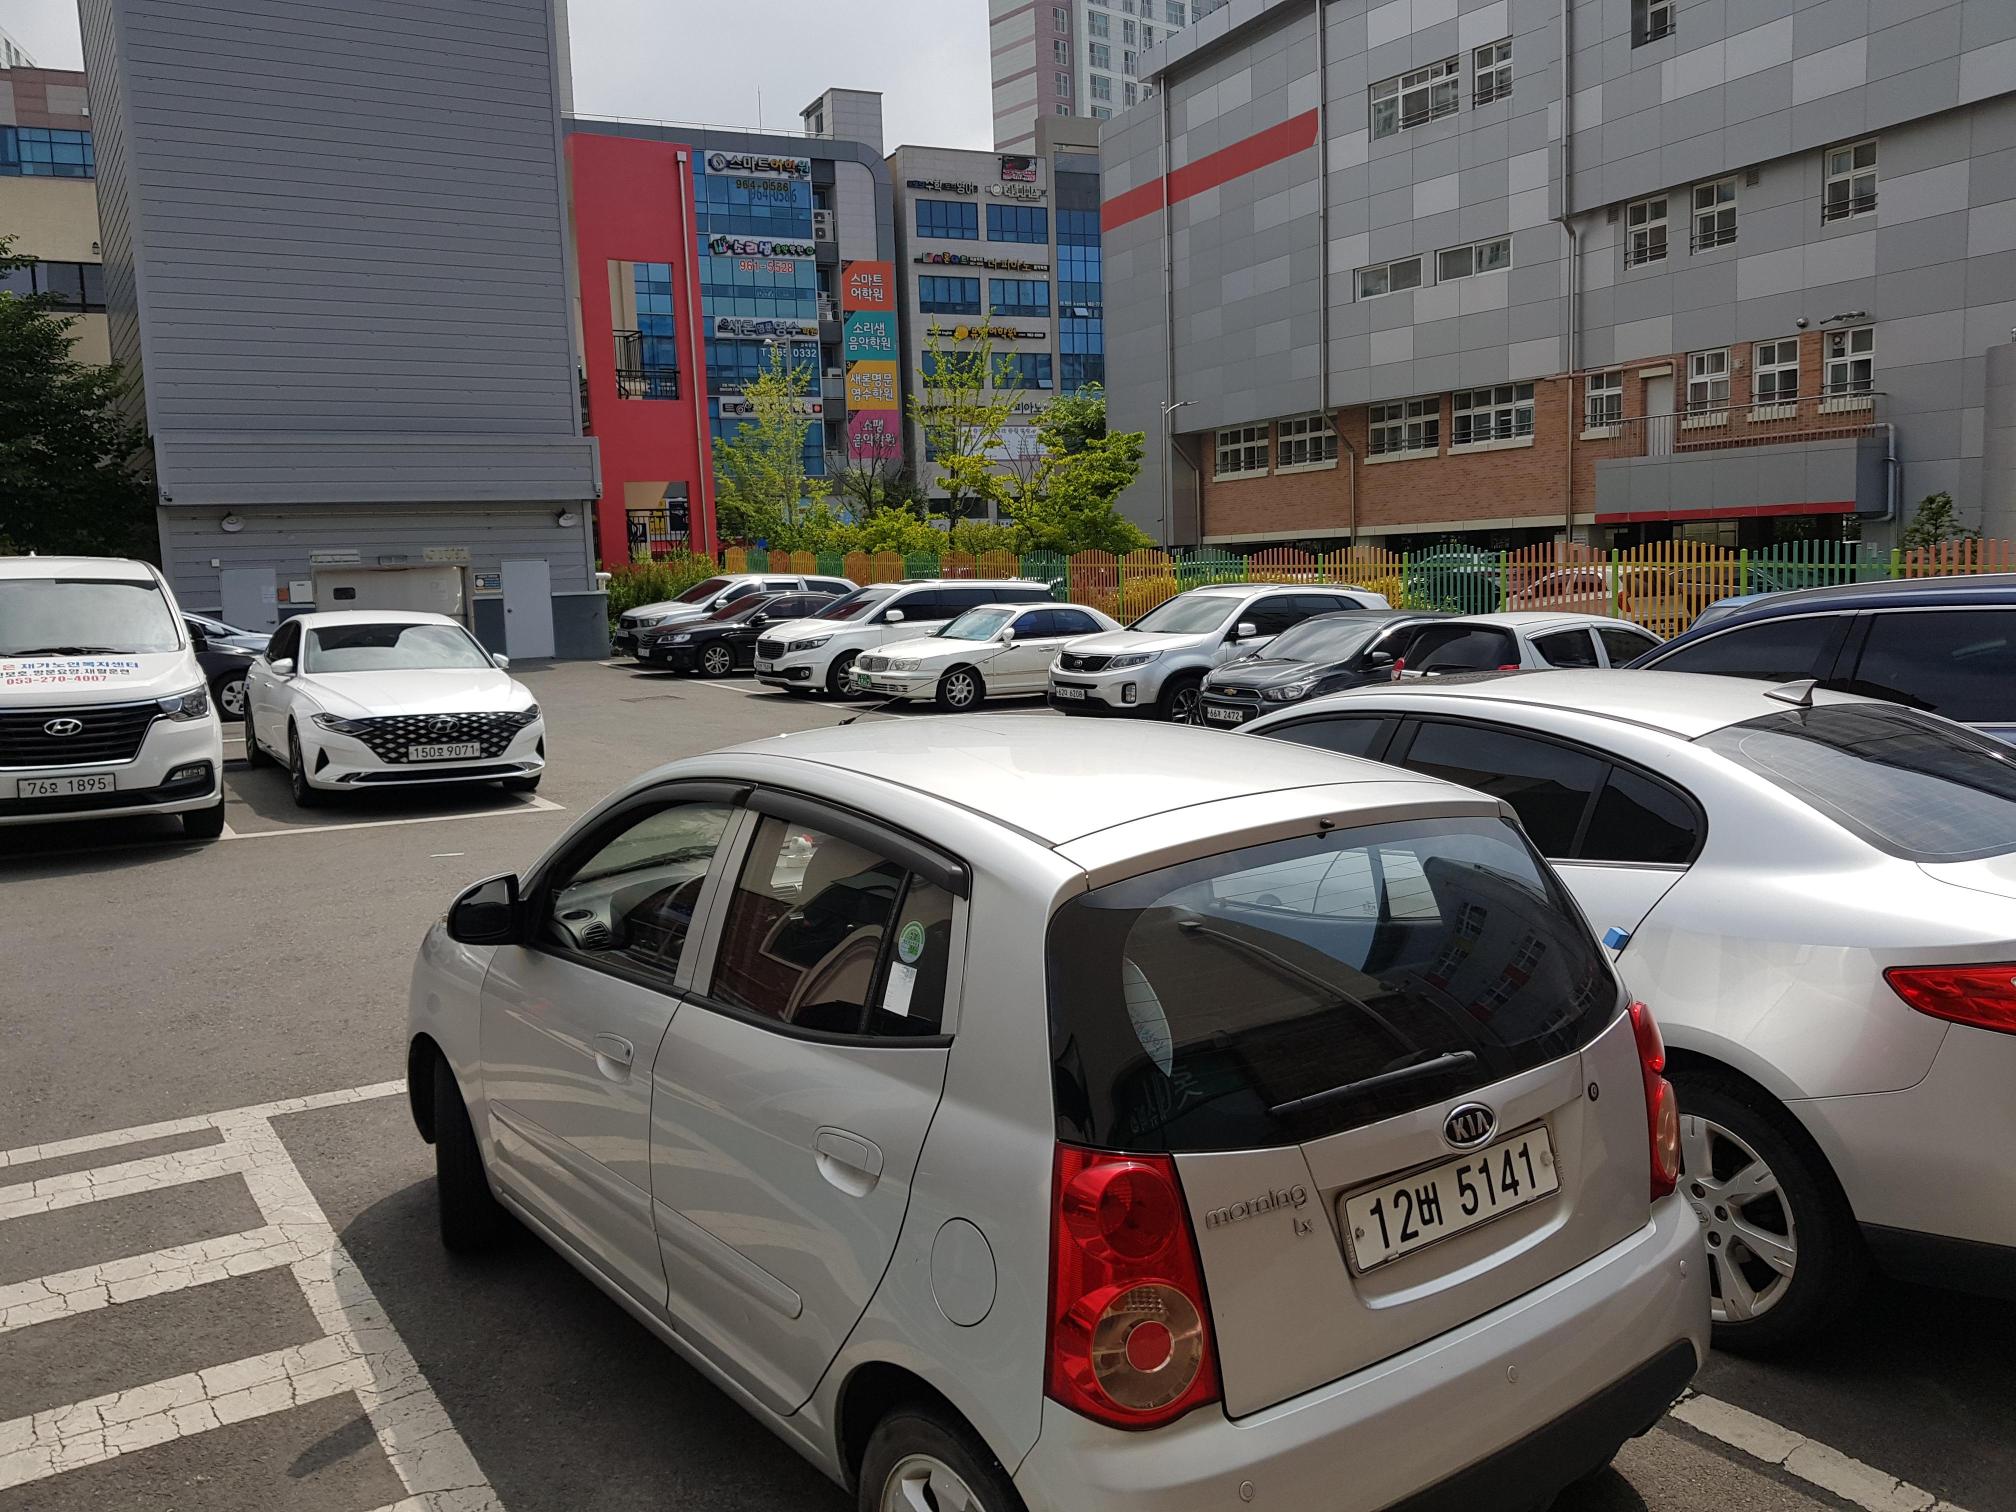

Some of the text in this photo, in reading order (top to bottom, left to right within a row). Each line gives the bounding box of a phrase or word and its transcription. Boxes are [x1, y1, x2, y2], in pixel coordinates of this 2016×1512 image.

[735, 179, 789, 192] 964-0586
[739, 260, 794, 273] 961-5528
[850, 273, 884, 287] 스마트
[850, 287, 884, 302] 어학원
[852, 321, 885, 336] 소리샘
[848, 336, 891, 352] 음악학원
[793, 348, 817, 358] 0332
[850, 373, 893, 387] 새론명문
[850, 388, 894, 402] 영수학원
[446, 744, 475, 757] 9071
[66, 777, 107, 793] 1895
[1451, 1114, 1490, 1141] KIA
[1369, 1180, 1444, 1249] 12버
[1455, 1142, 1537, 1216] 5141
[1205, 1184, 1308, 1231] morning
